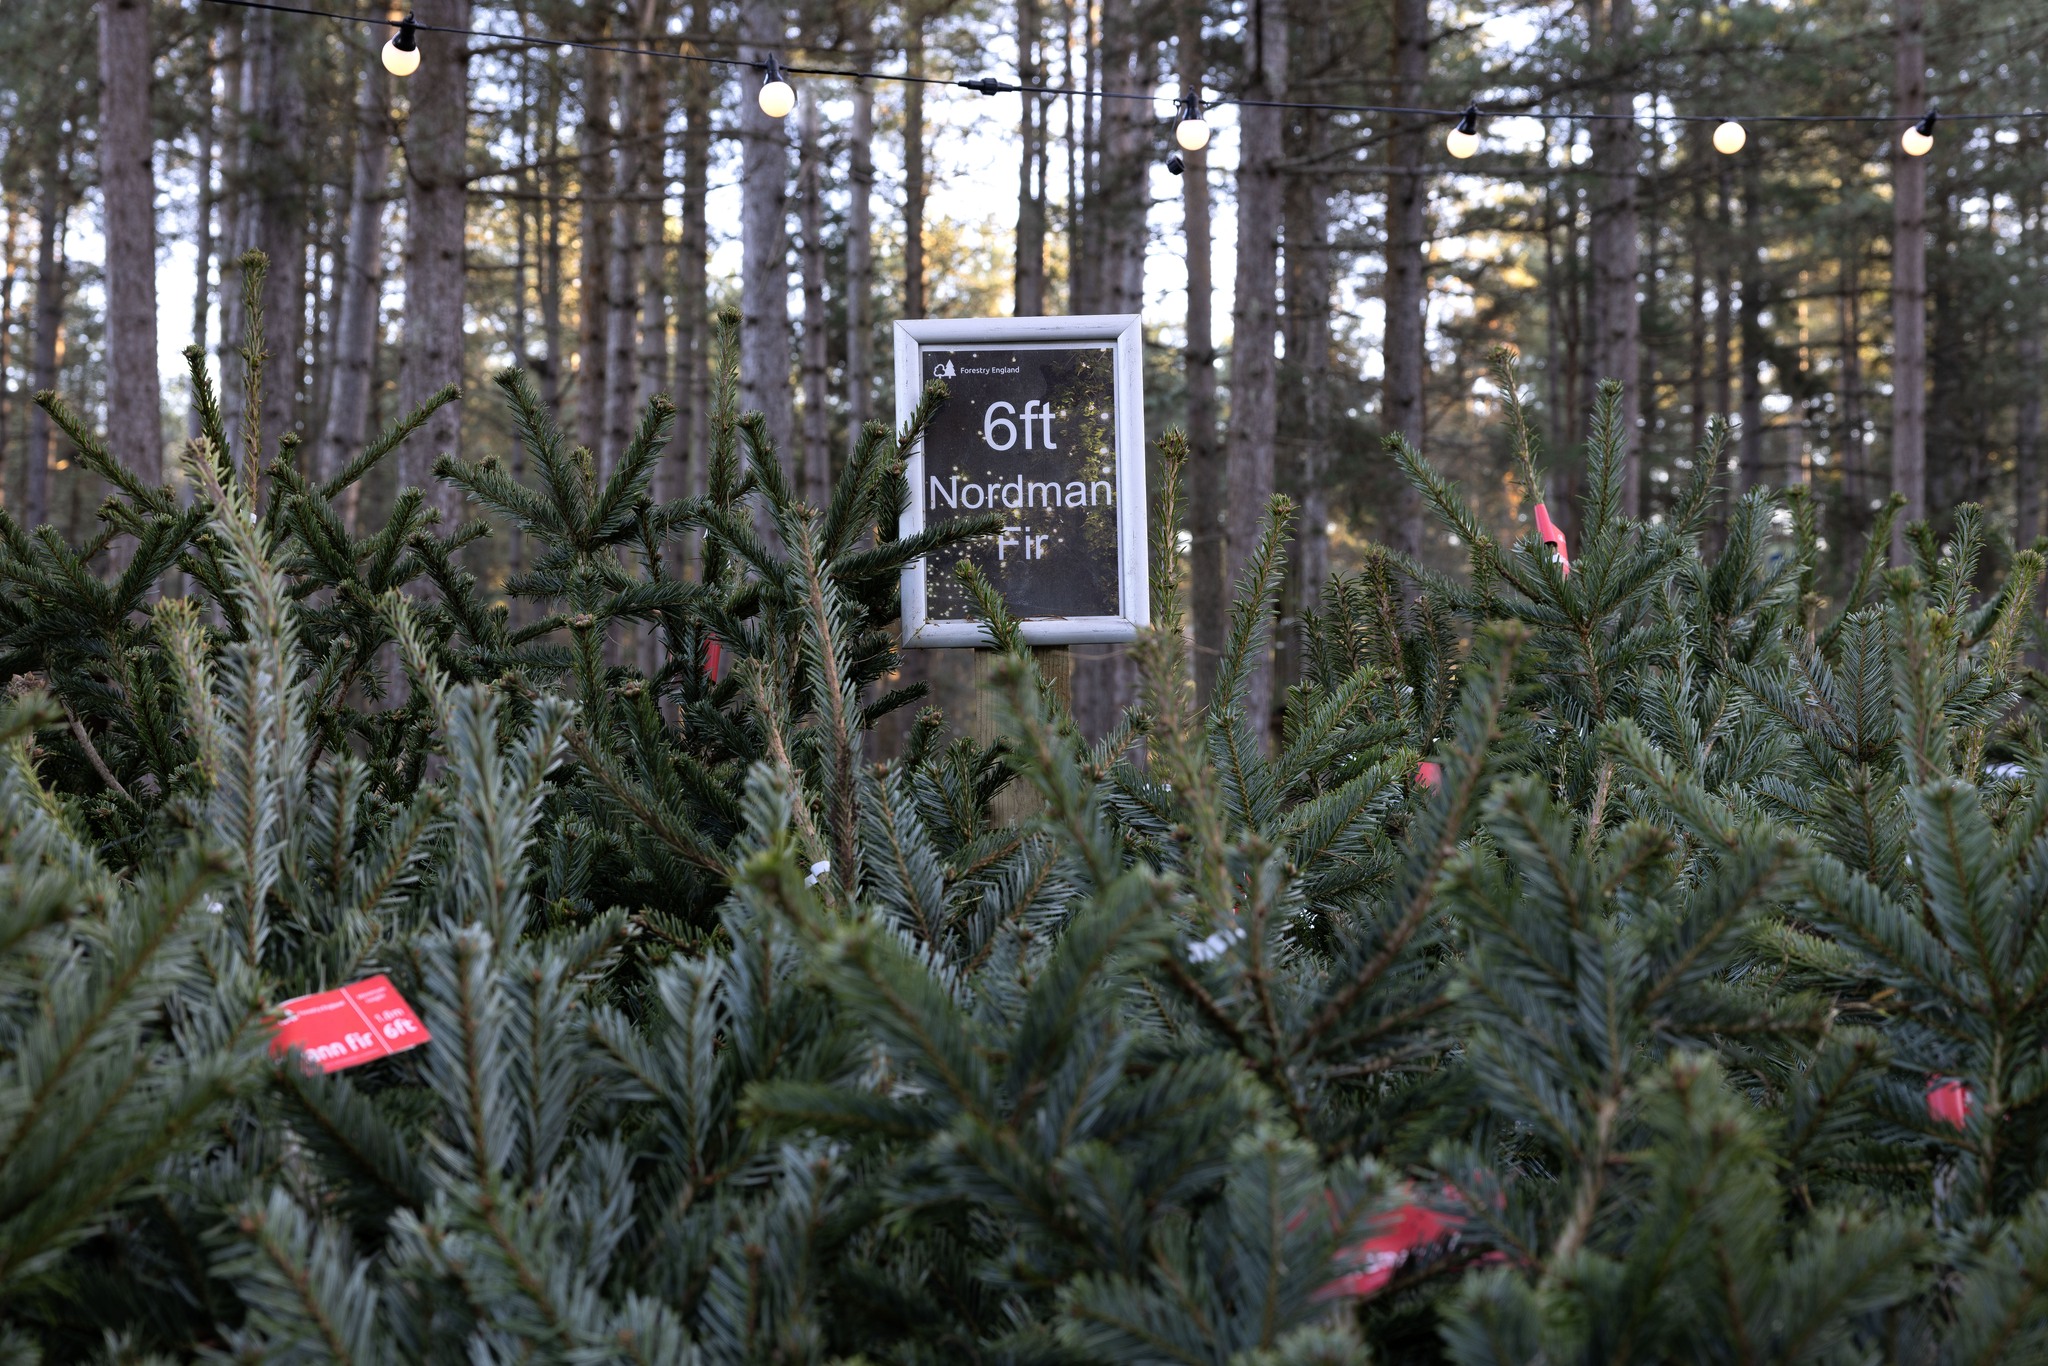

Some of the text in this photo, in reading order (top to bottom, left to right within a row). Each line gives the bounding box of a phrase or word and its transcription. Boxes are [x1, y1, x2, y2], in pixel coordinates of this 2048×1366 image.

[960, 366, 1020, 375] Forestry England
[983, 399, 1057, 452] 6ft
[930, 474, 1113, 510] Nordman
[997, 526, 1050, 561] Fir
[344, 1031, 374, 1052] fir
[383, 1018, 418, 1039] 6ft
